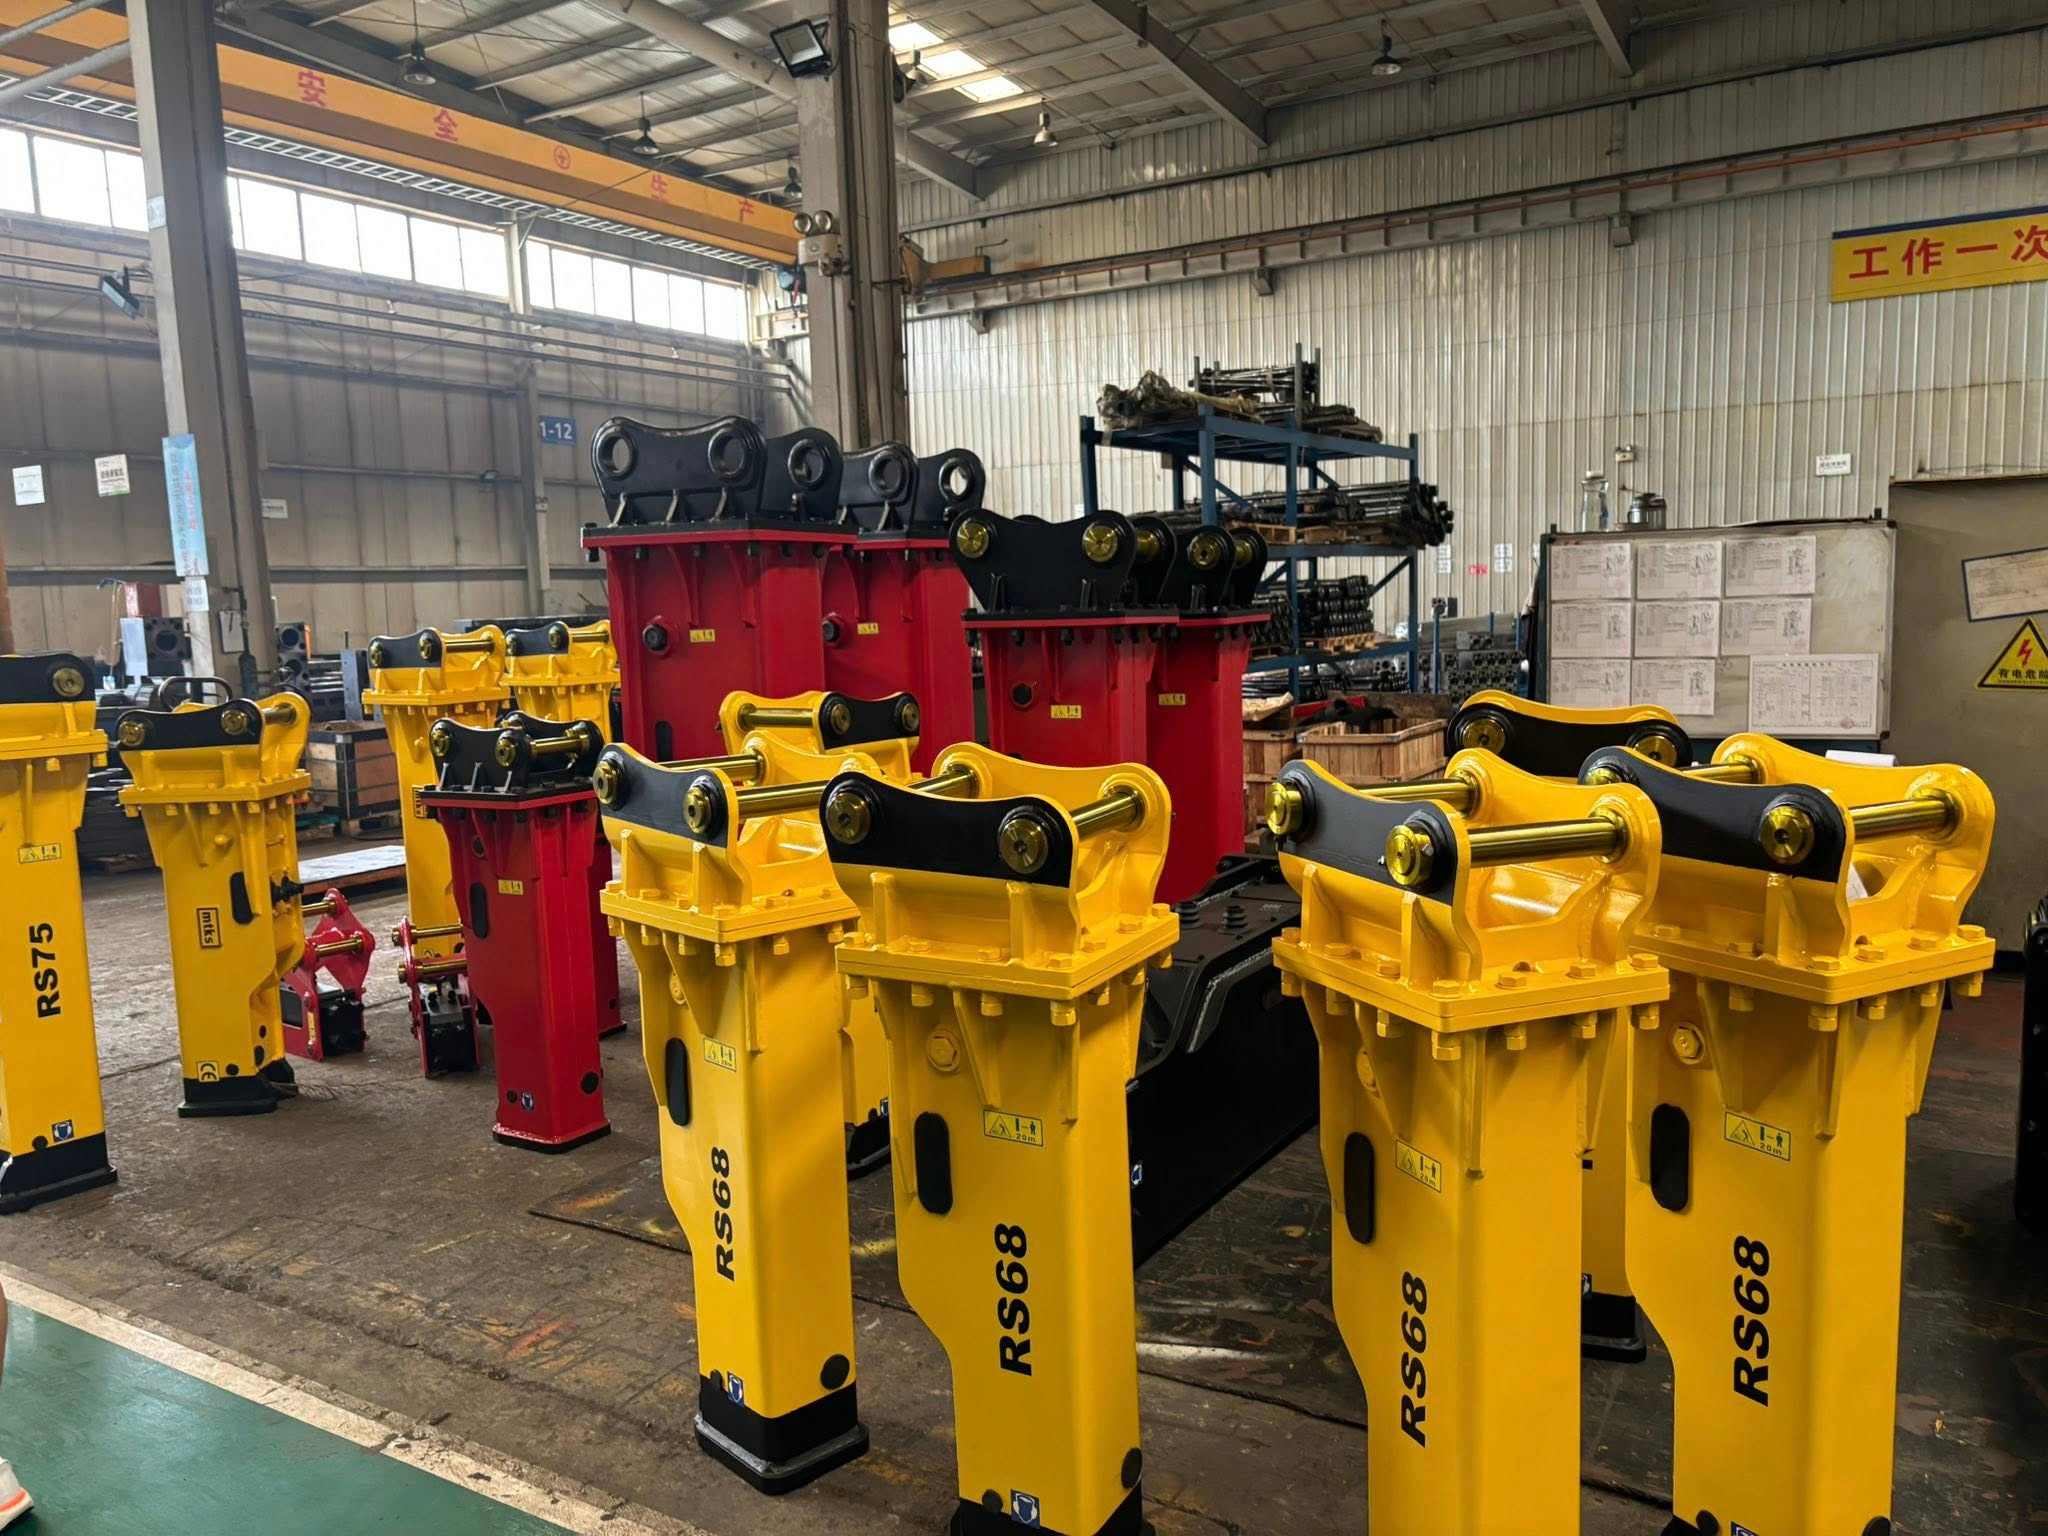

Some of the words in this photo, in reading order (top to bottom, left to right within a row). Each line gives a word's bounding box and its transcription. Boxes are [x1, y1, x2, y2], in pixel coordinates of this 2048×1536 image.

[1848, 224, 2048, 279] 工作一次
[539, 420, 574, 440] 1-12
[29, 922, 62, 1018] RS75
[710, 1146, 736, 1281] RS68
[993, 1223, 1034, 1377] RS68
[1400, 1271, 1428, 1449] RS68
[1733, 1235, 1770, 1409] RS68
